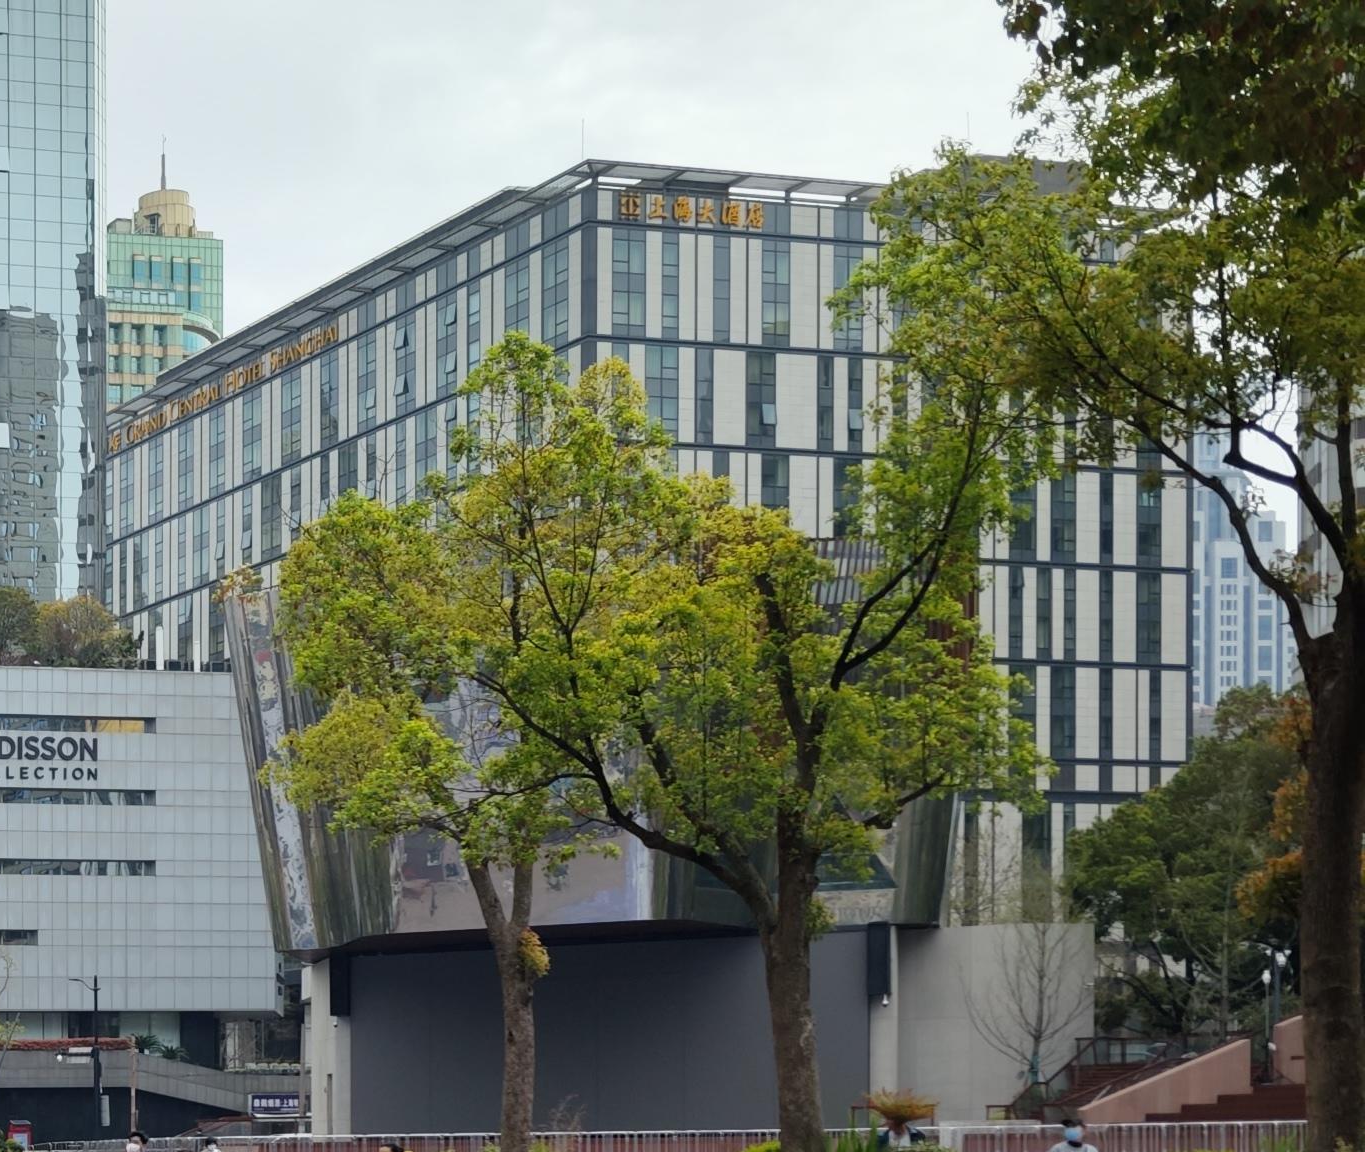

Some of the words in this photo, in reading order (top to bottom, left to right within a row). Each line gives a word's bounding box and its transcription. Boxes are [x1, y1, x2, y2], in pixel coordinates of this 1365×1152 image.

[649, 195, 764, 228] 上海大酒店
[224, 361, 266, 394] HOTEL
[269, 324, 339, 372] SHANGHAI
